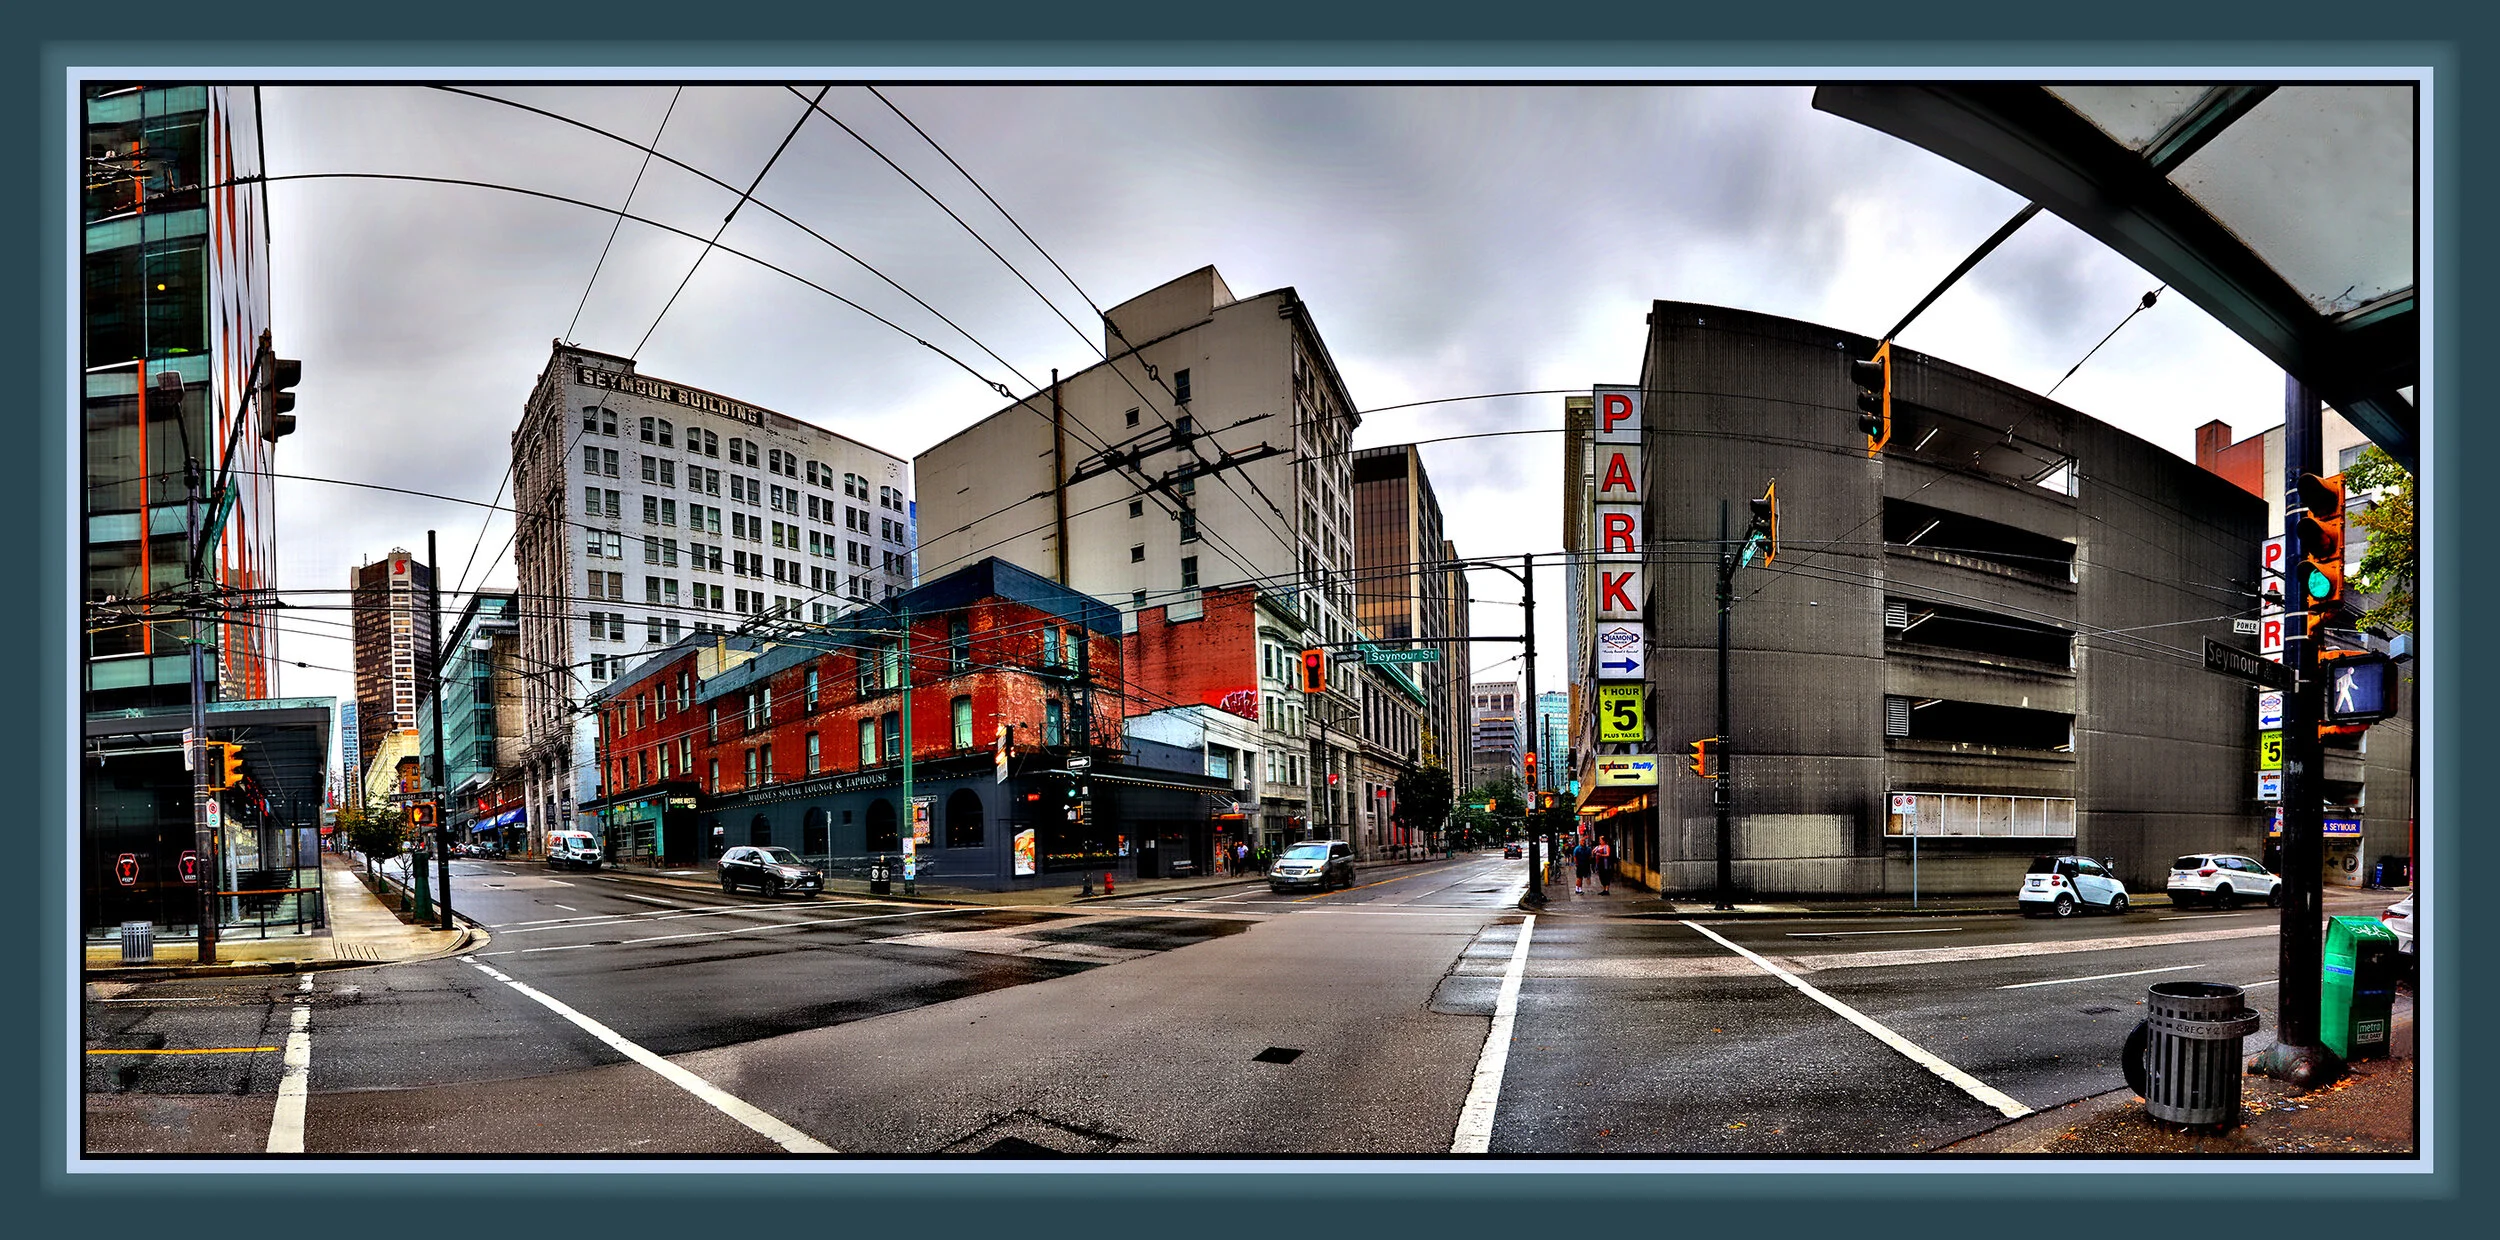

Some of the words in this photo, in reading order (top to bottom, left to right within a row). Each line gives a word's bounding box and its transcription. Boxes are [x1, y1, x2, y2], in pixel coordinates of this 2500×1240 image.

[583, 369, 671, 401] SEYMOUR
[678, 390, 758, 424] BUILDING
[1601, 394, 1638, 612] PARK
[2237, 622, 2257, 630] POWER
[1601, 634, 1640, 643] DIAMOND
[1372, 652, 1417, 662] Seymour
[1423, 650, 1434, 659] St
[2208, 642, 2260, 675] Seymour
[1632, 762, 1654, 771] Thrifty
[779, 786, 801, 798] SOCIAL
[804, 780, 832, 794] LOUNGE
[836, 780, 843, 789] &
[845, 773, 888, 788] TAPHOUSE
[2330, 823, 2356, 831] SEYMOUR
[2347, 857, 2355, 869] P
[2360, 1023, 2381, 1033] metro
